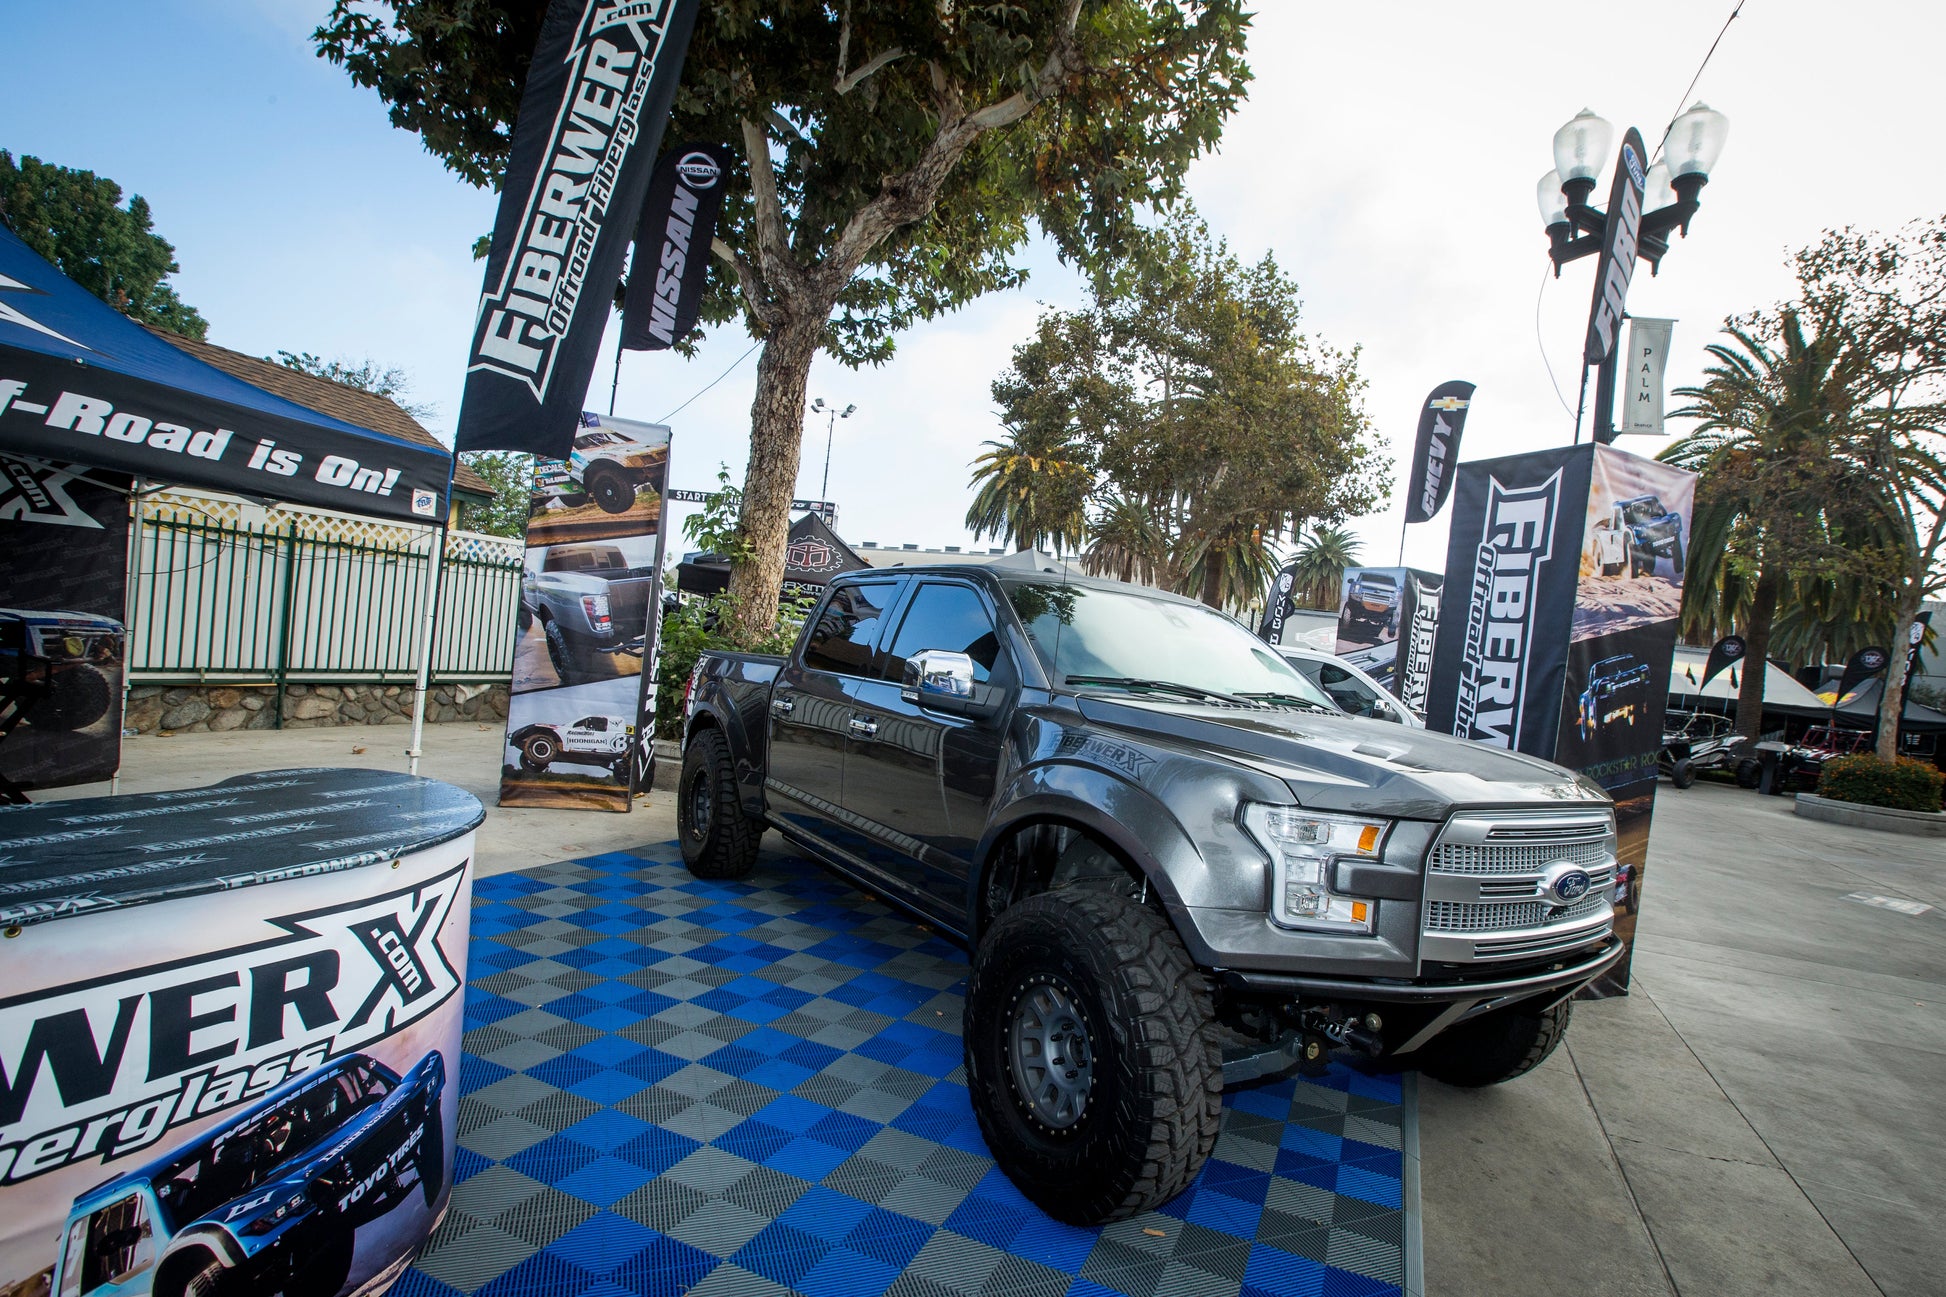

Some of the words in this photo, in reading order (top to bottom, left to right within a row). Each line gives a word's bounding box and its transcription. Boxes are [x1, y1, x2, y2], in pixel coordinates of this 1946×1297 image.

[680, 166, 718, 176] NISSAN
[649, 184, 700, 345] NISSAN
[1594, 177, 1640, 357] FORD
[1638, 347, 1653, 403] PALM
[248, 438, 303, 477] is
[315, 455, 402, 496] On!
[676, 490, 707, 501] START
[1423, 412, 1457, 517] CHEVY
[1563, 876, 1586, 896] Ford
[370, 928, 422, 994] .com
[0, 1042, 329, 1178] erglass
[338, 1161, 388, 1213] TOYO
[387, 1121, 424, 1169] TIRES
